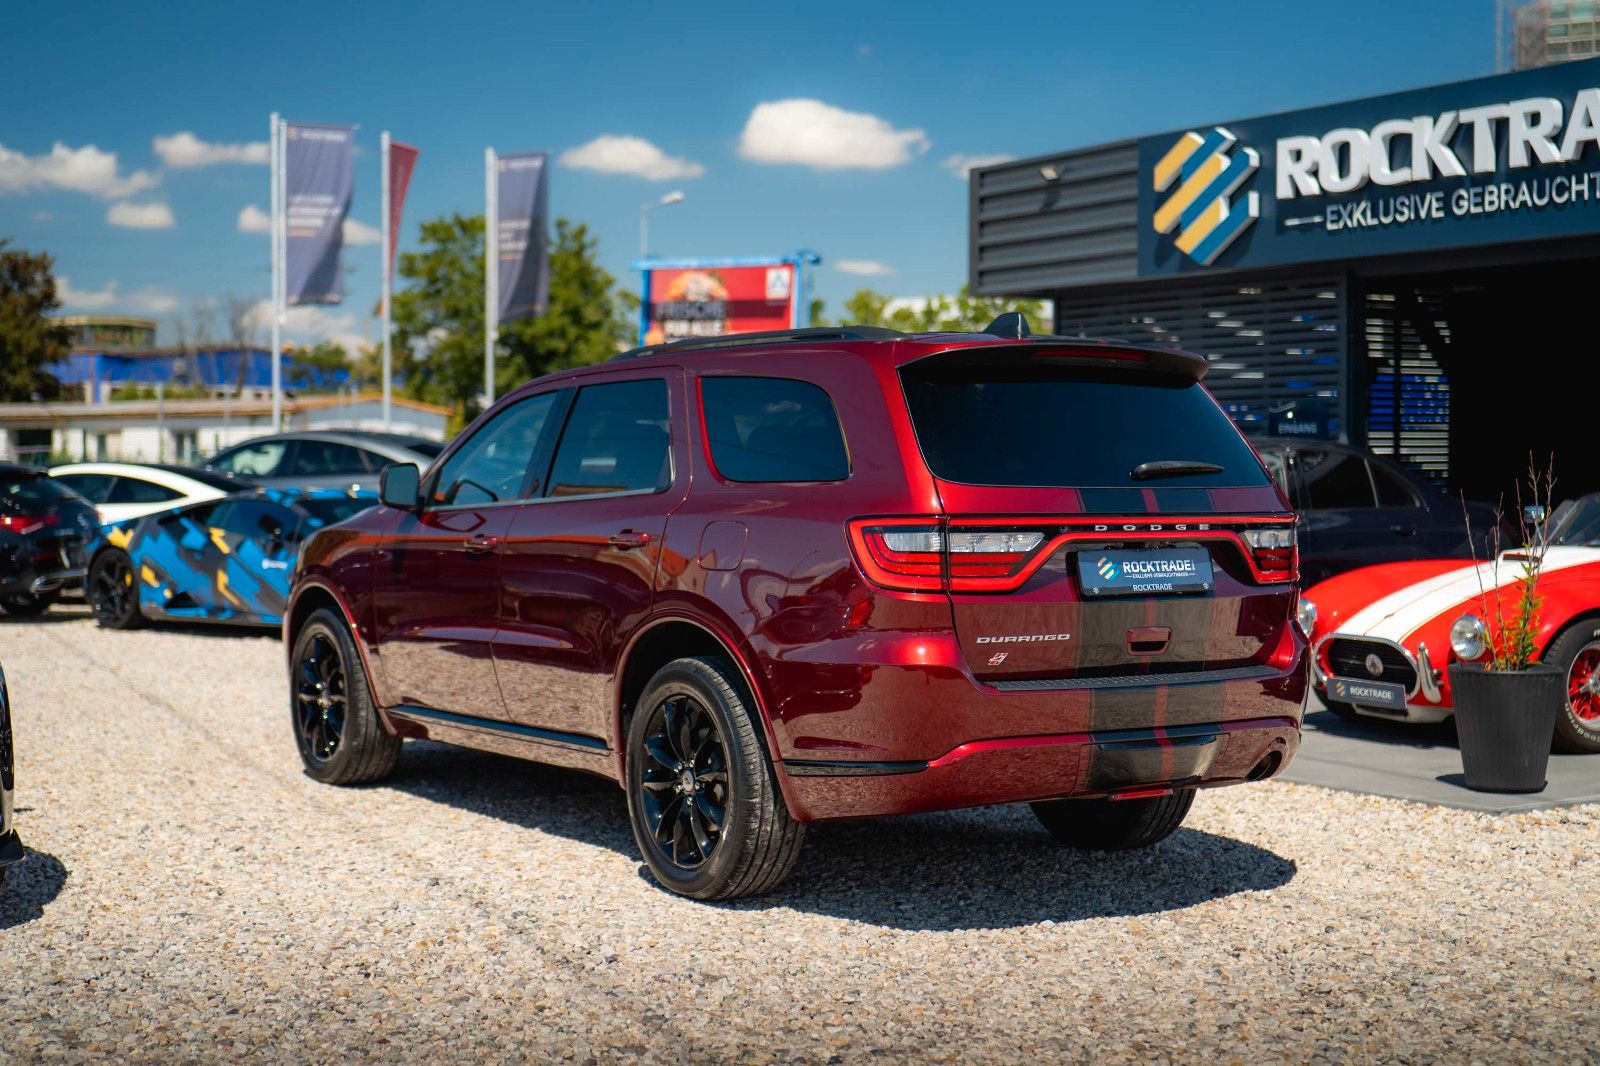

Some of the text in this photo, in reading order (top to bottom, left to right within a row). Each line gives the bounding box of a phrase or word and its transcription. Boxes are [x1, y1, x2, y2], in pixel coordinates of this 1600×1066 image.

[1326, 191, 1445, 231] EXKLUSIVE
[1094, 524, 1210, 532] DODGE
[1122, 559, 1192, 573] ROCKTRADE
[1132, 583, 1173, 592] ROCKTRADE
[976, 633, 1071, 644] DURANGO
[1349, 686, 1392, 700] ROCKTRADE
